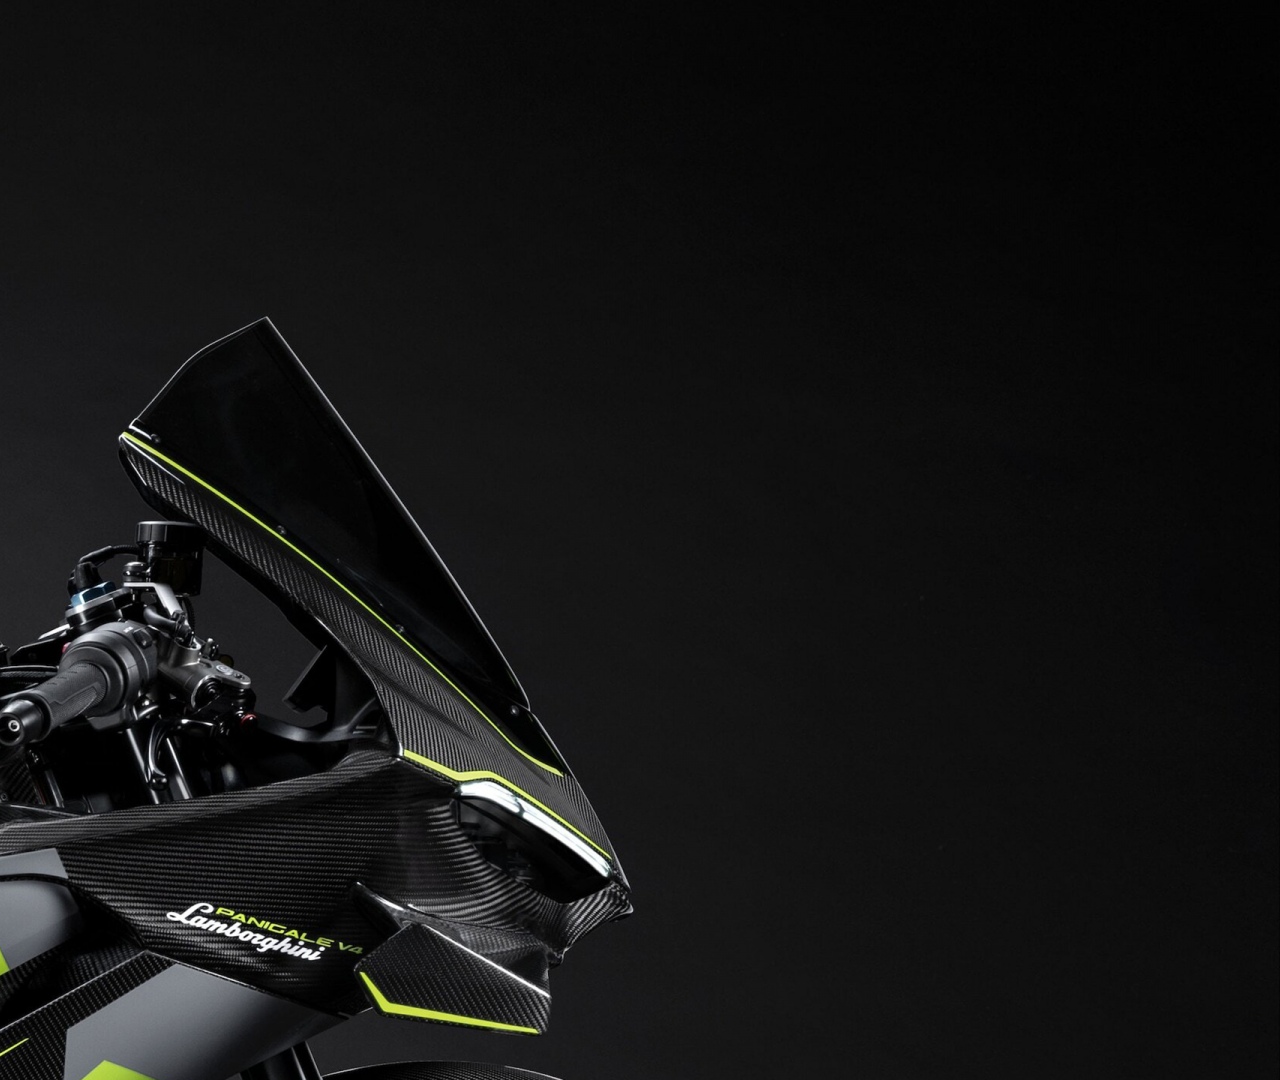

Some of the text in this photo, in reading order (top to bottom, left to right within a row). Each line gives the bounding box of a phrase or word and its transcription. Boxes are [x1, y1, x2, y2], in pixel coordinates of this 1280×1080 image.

[166, 902, 326, 961] Lamborghini
[215, 906, 364, 955] PANIGALE V4
